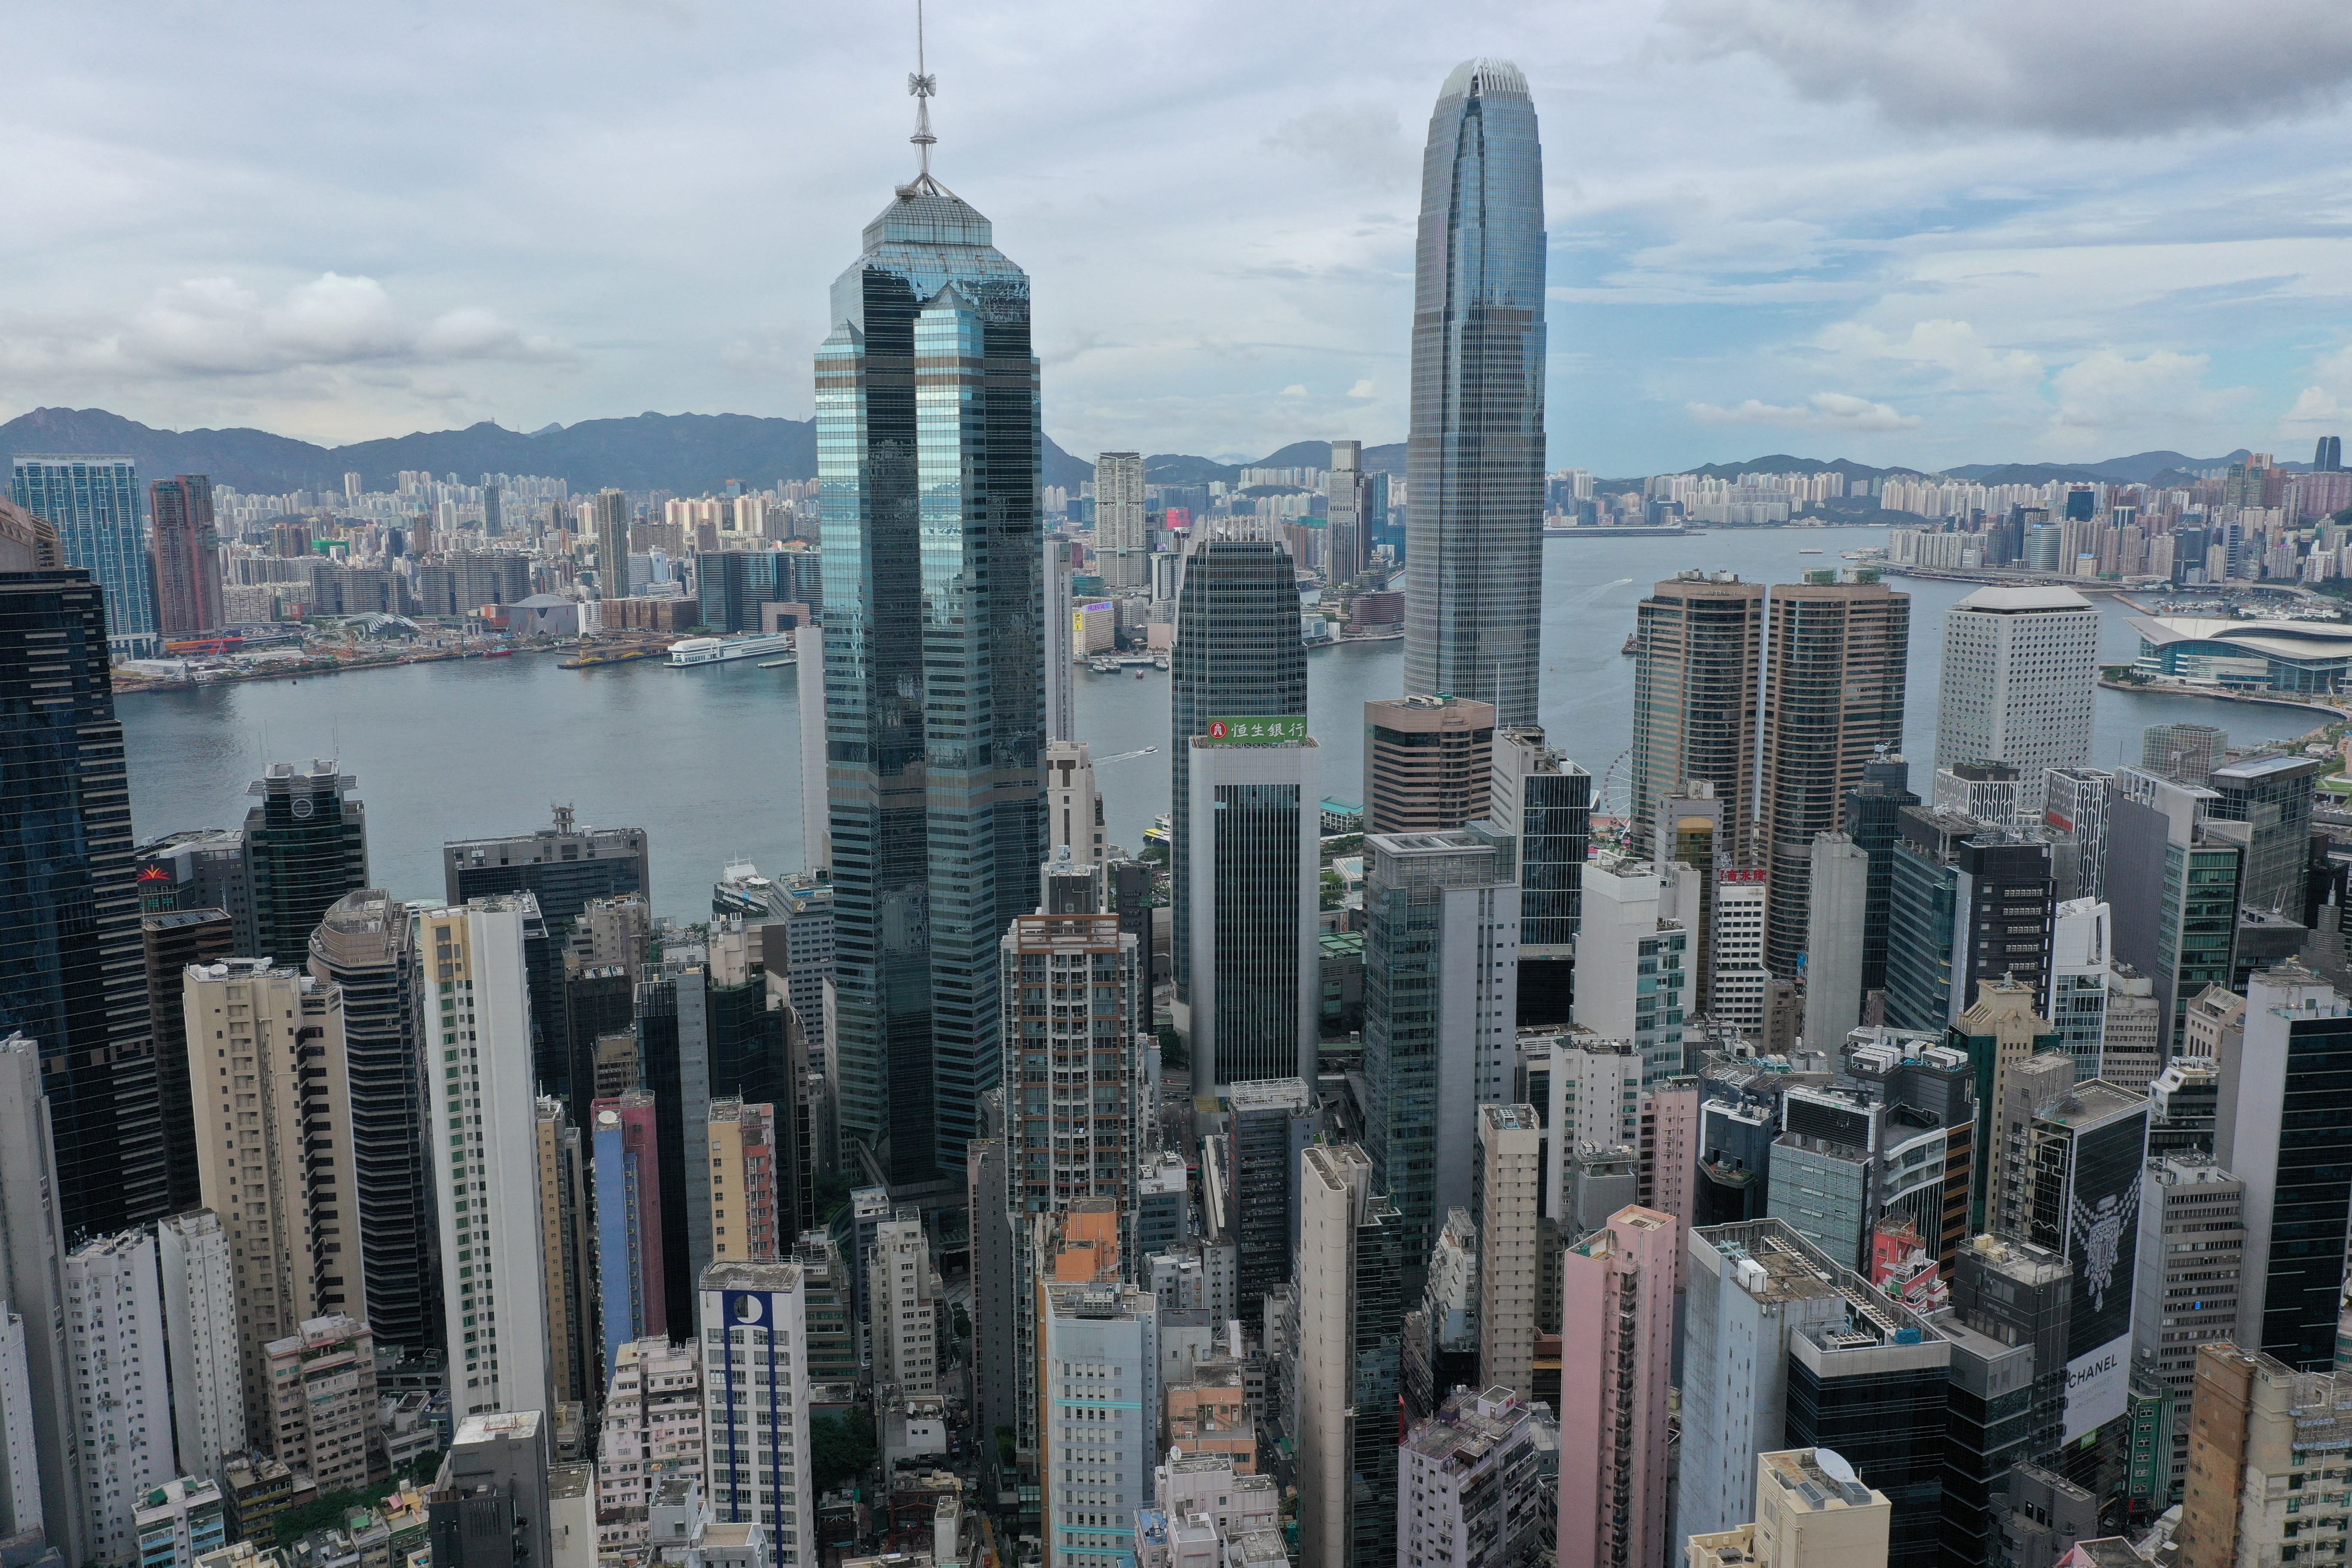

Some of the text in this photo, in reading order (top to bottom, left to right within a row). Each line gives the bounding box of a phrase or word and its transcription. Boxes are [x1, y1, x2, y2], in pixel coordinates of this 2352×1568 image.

[1231, 723, 1305, 738] 恒生銀行
[2068, 1354, 2117, 1388] CHANEL
